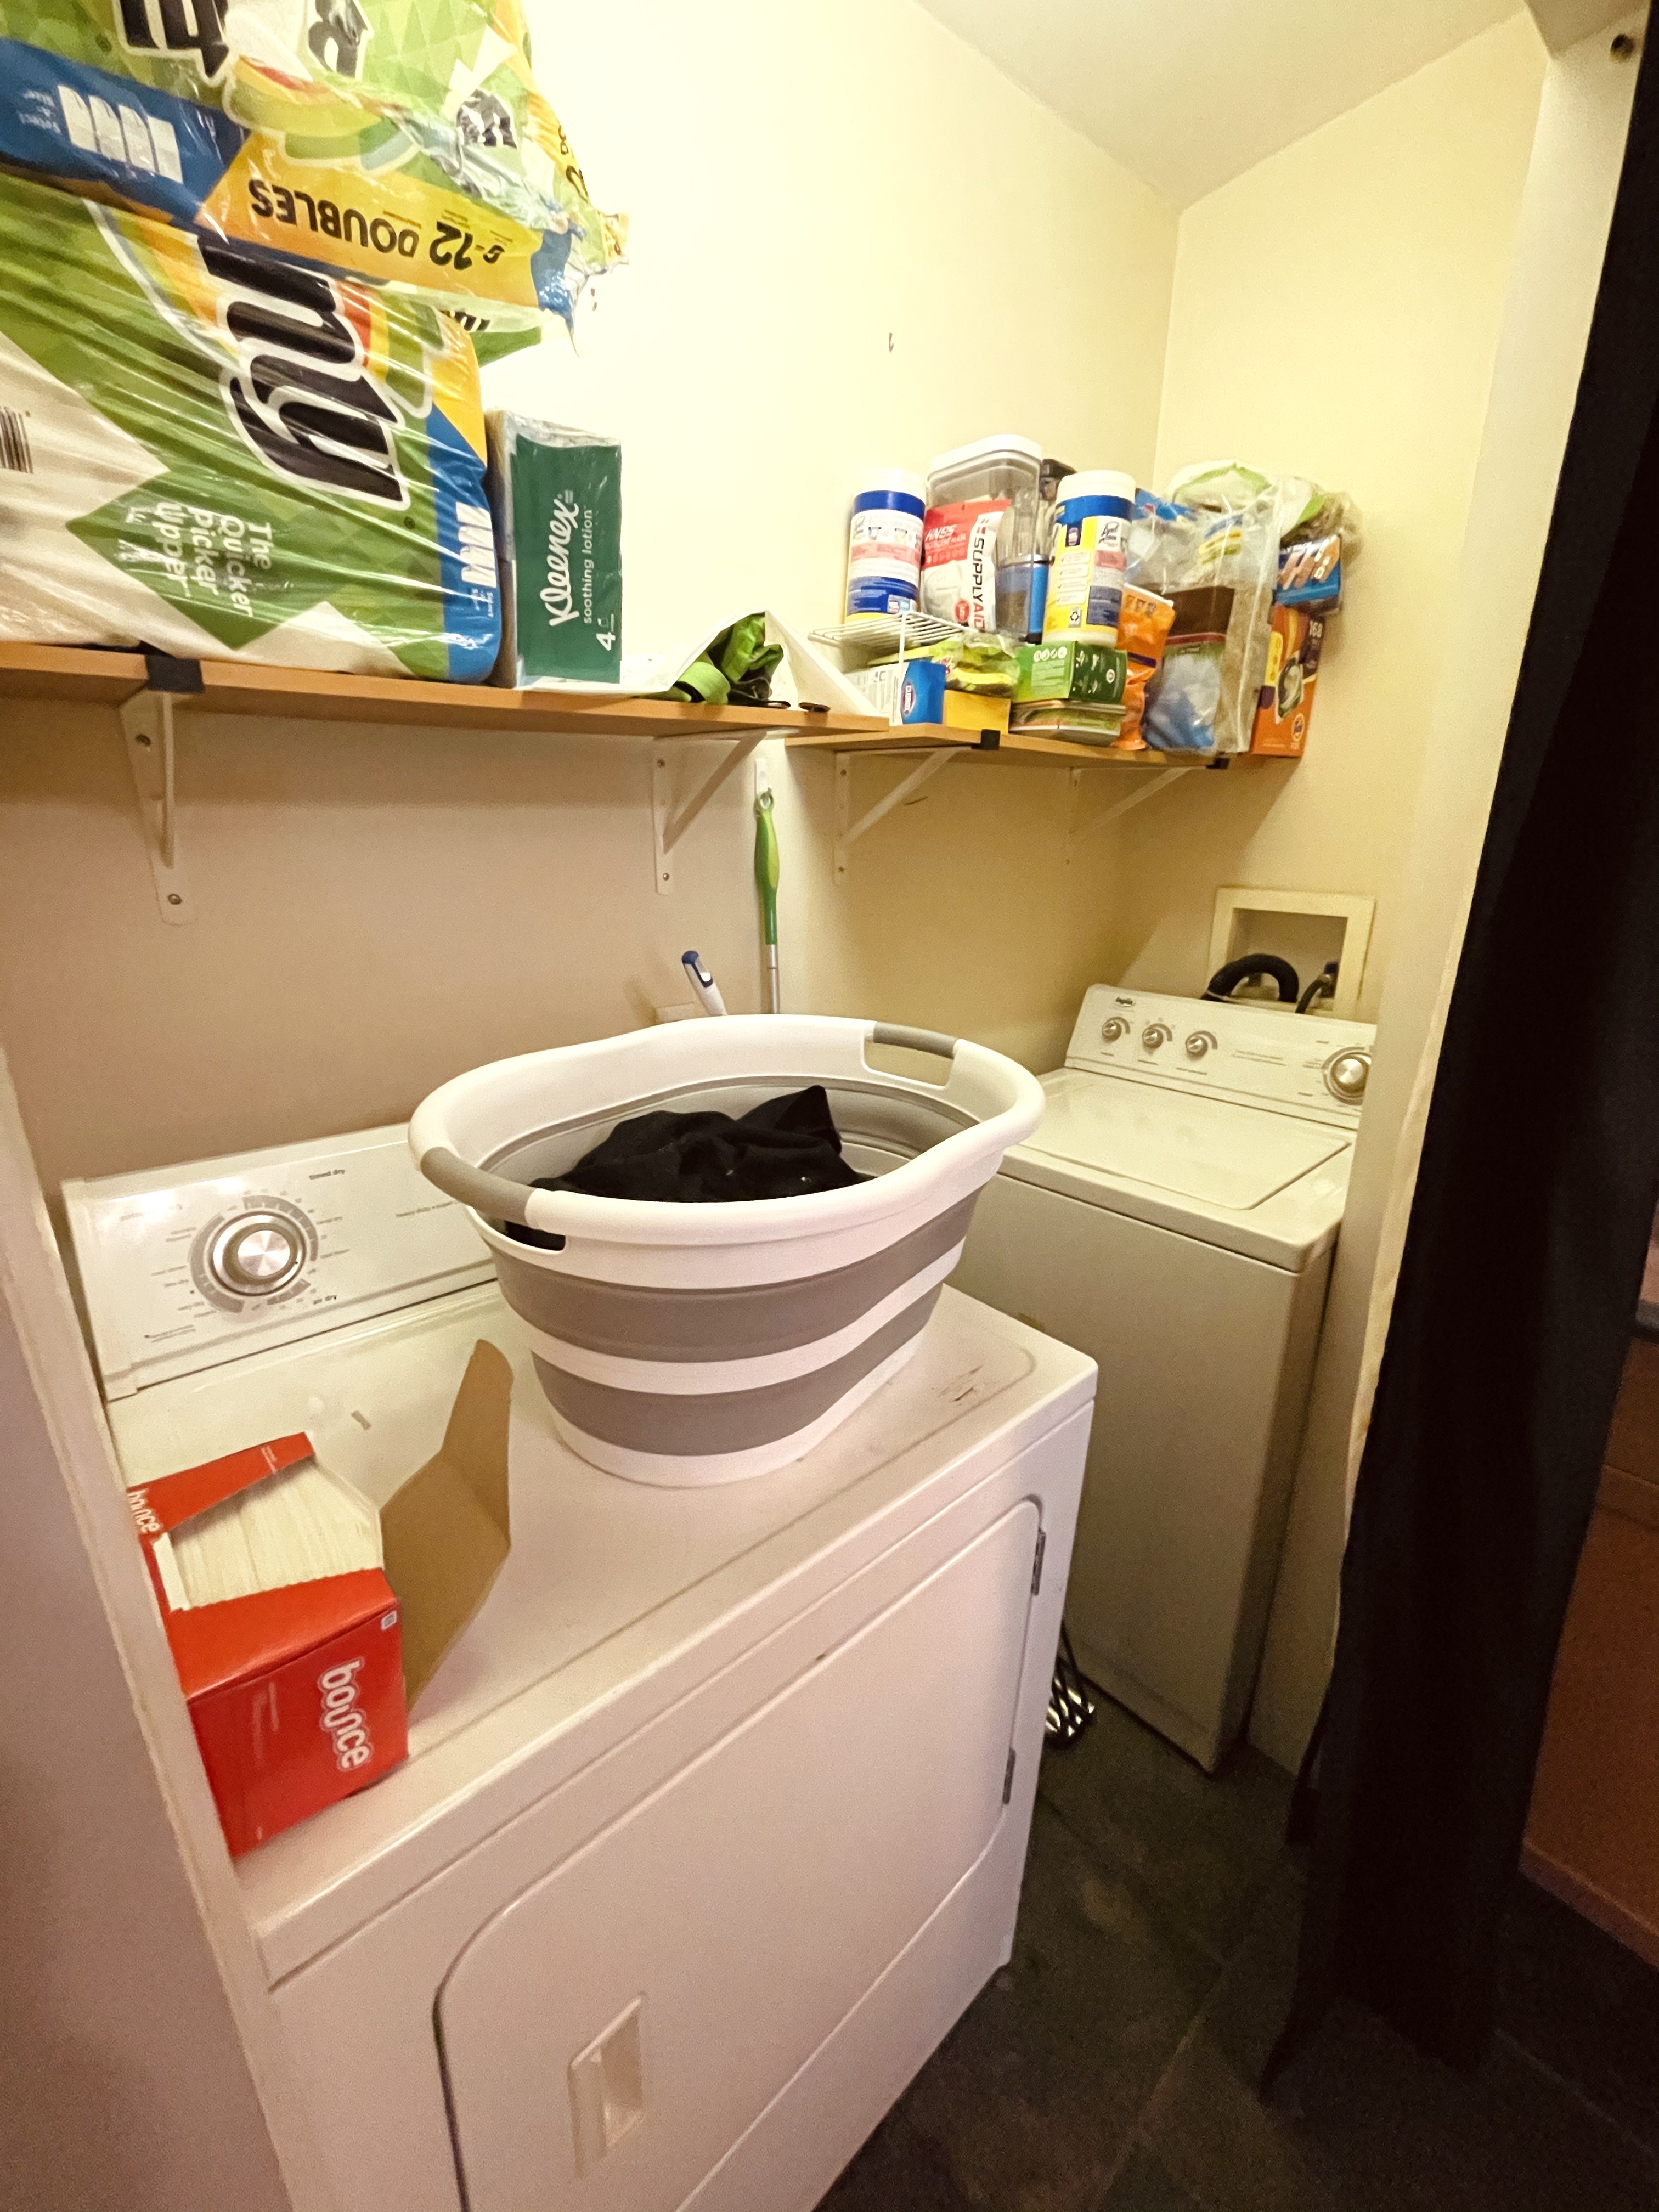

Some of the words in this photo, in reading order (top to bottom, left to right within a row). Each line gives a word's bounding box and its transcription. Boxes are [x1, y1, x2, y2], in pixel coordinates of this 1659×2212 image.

[249, 179, 420, 258] DOUBLES
[188, 507, 219, 596] Picker
[219, 514, 254, 618] Quicker
[248, 522, 274, 569] The
[540, 498, 579, 627] Kleenex
[582, 508, 593, 556] lotion
[582, 559, 594, 624] soothing
[596, 632, 616, 651] 4
[321, 1660, 372, 1769] bounce
